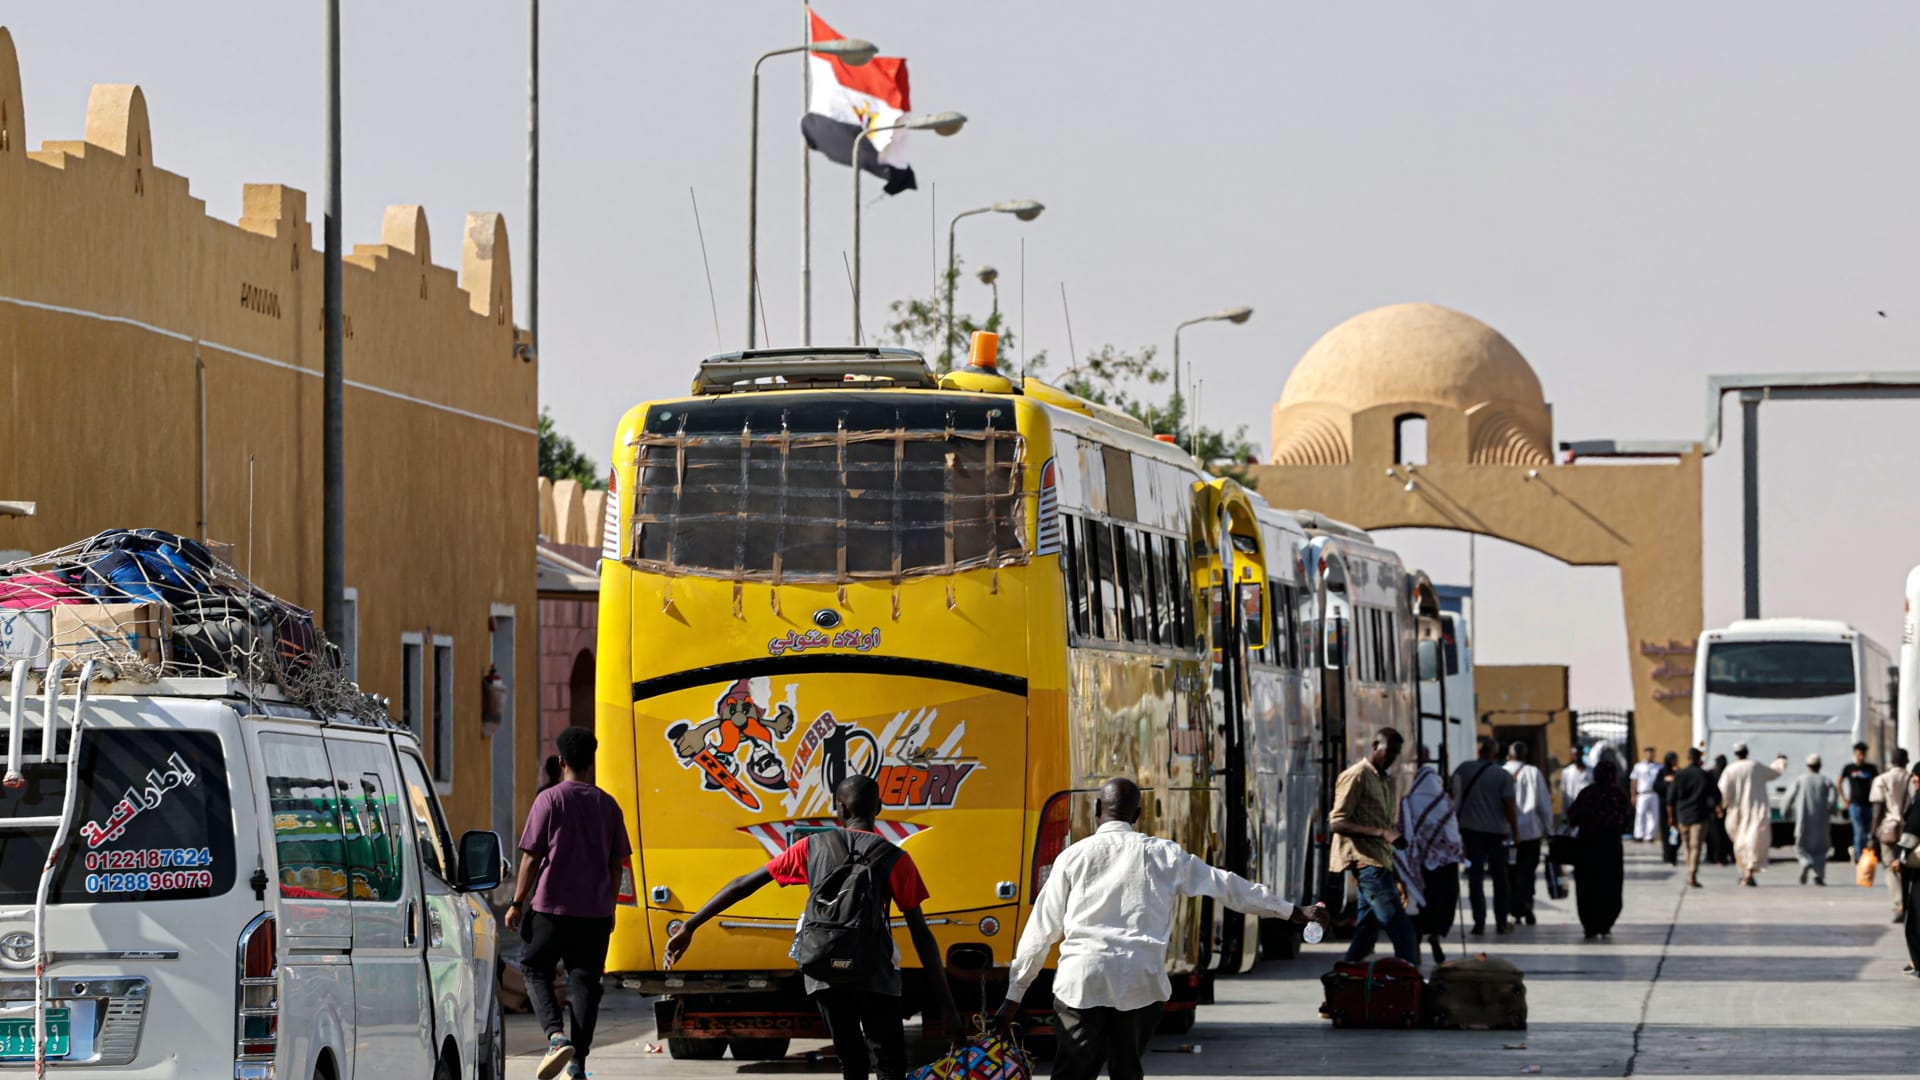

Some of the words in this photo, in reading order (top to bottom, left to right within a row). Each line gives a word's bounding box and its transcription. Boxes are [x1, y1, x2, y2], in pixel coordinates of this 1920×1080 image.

[768, 630, 830, 655] متولي
[832, 627, 881, 651] أولاد
[787, 710, 837, 800] NUMBER
[81, 751, 196, 848] إماراتية
[86, 848, 211, 870] 0122187624
[86, 871, 212, 894] 0128896079
[832, 960, 852, 969] NIKE
